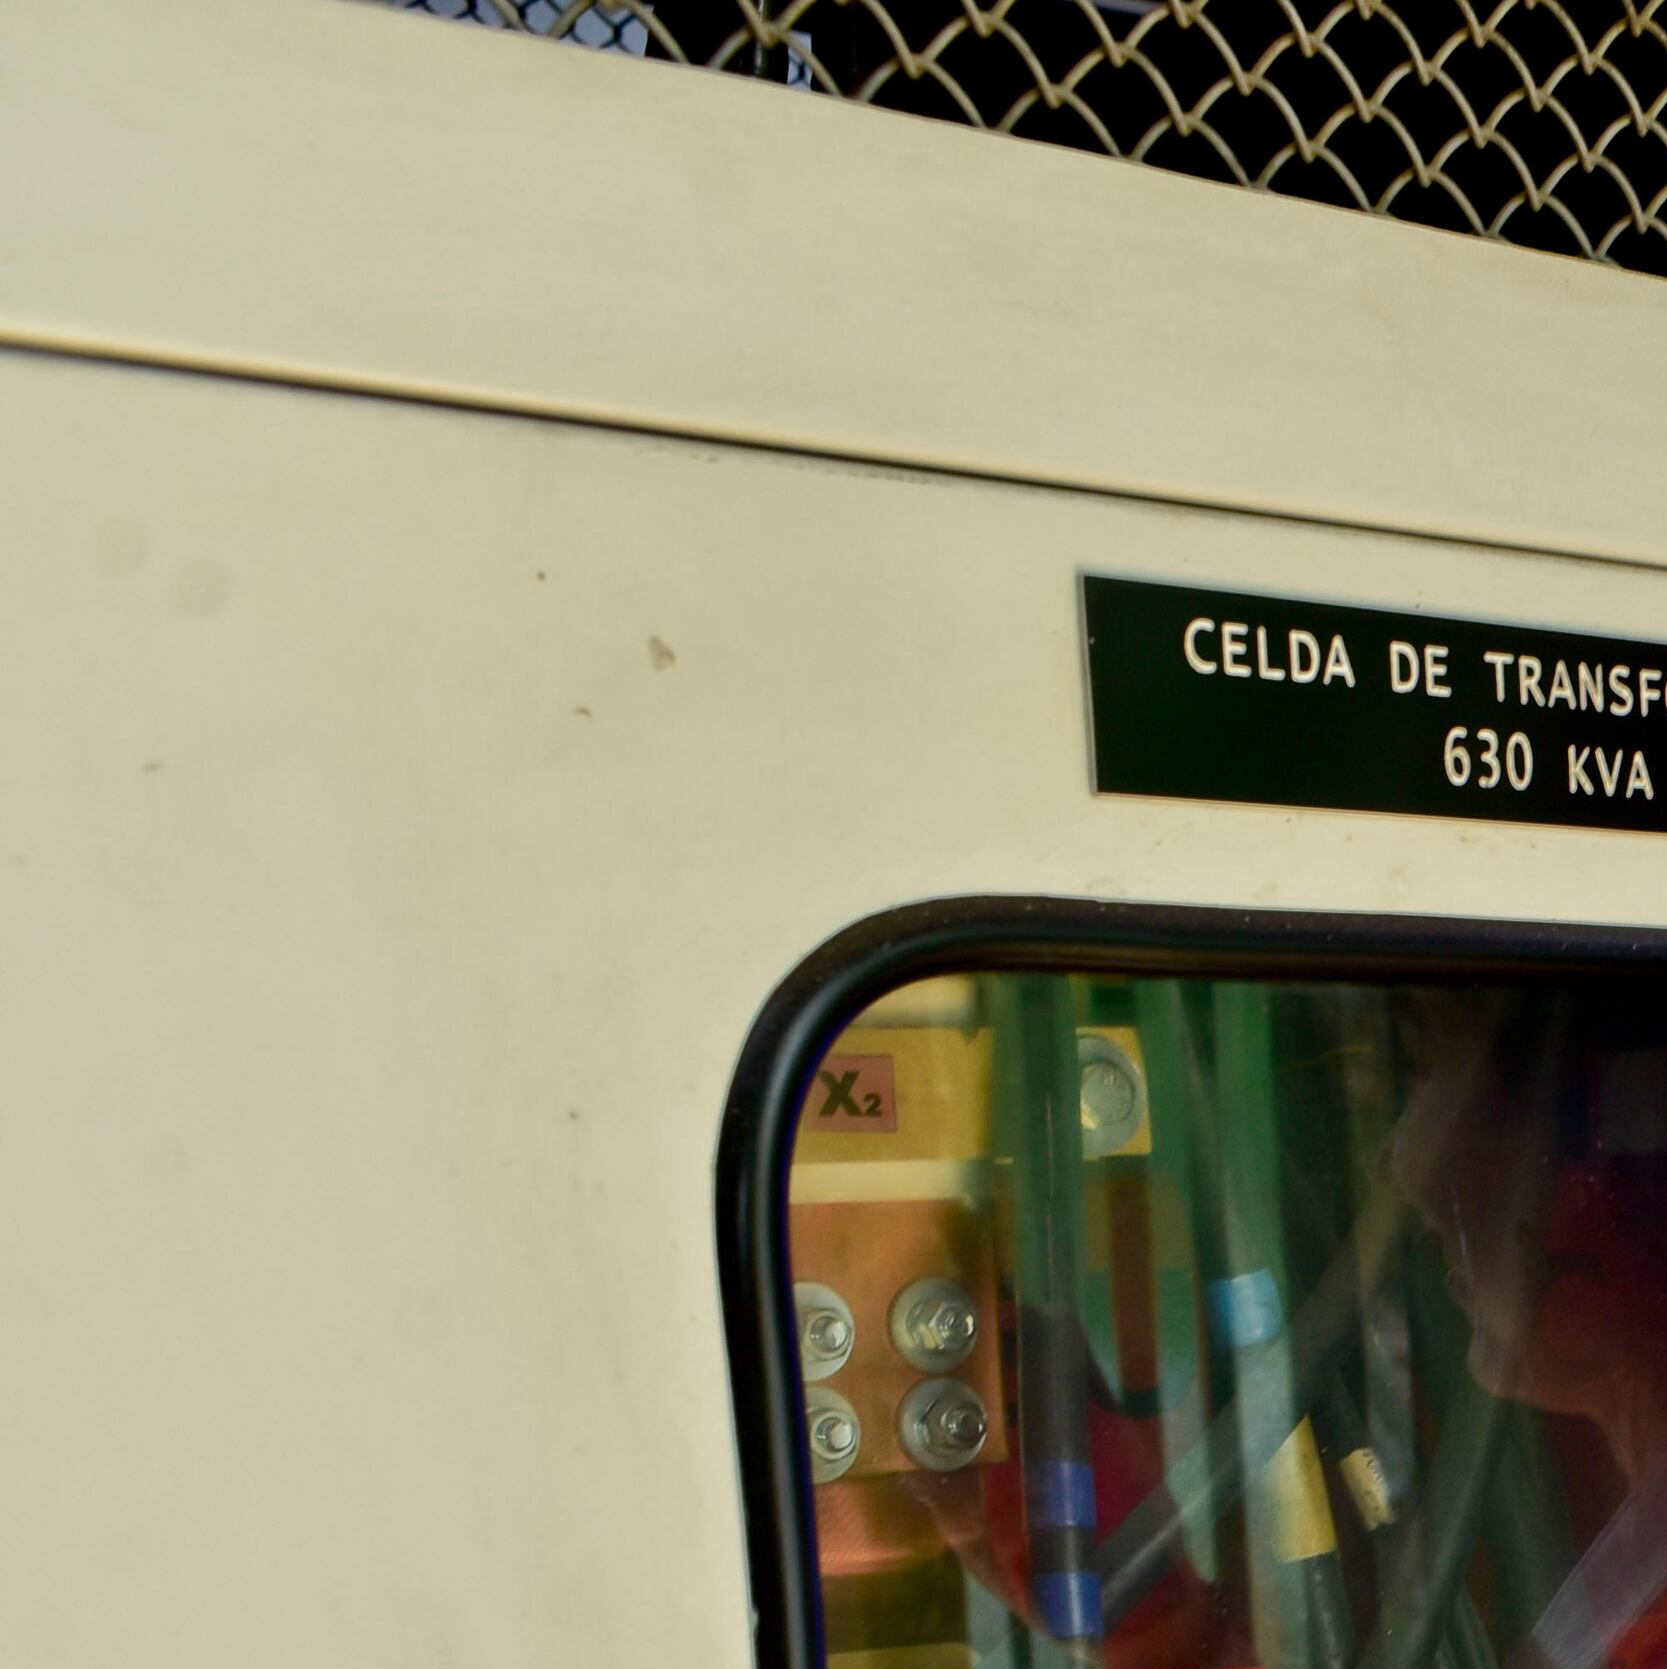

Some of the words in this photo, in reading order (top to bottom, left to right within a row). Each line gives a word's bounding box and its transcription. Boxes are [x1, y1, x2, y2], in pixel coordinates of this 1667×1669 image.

[1183, 617, 1356, 688] CELDA
[1389, 640, 1452, 698] DE
[1443, 726, 1534, 791] 630
[1567, 744, 1654, 801] KVA
